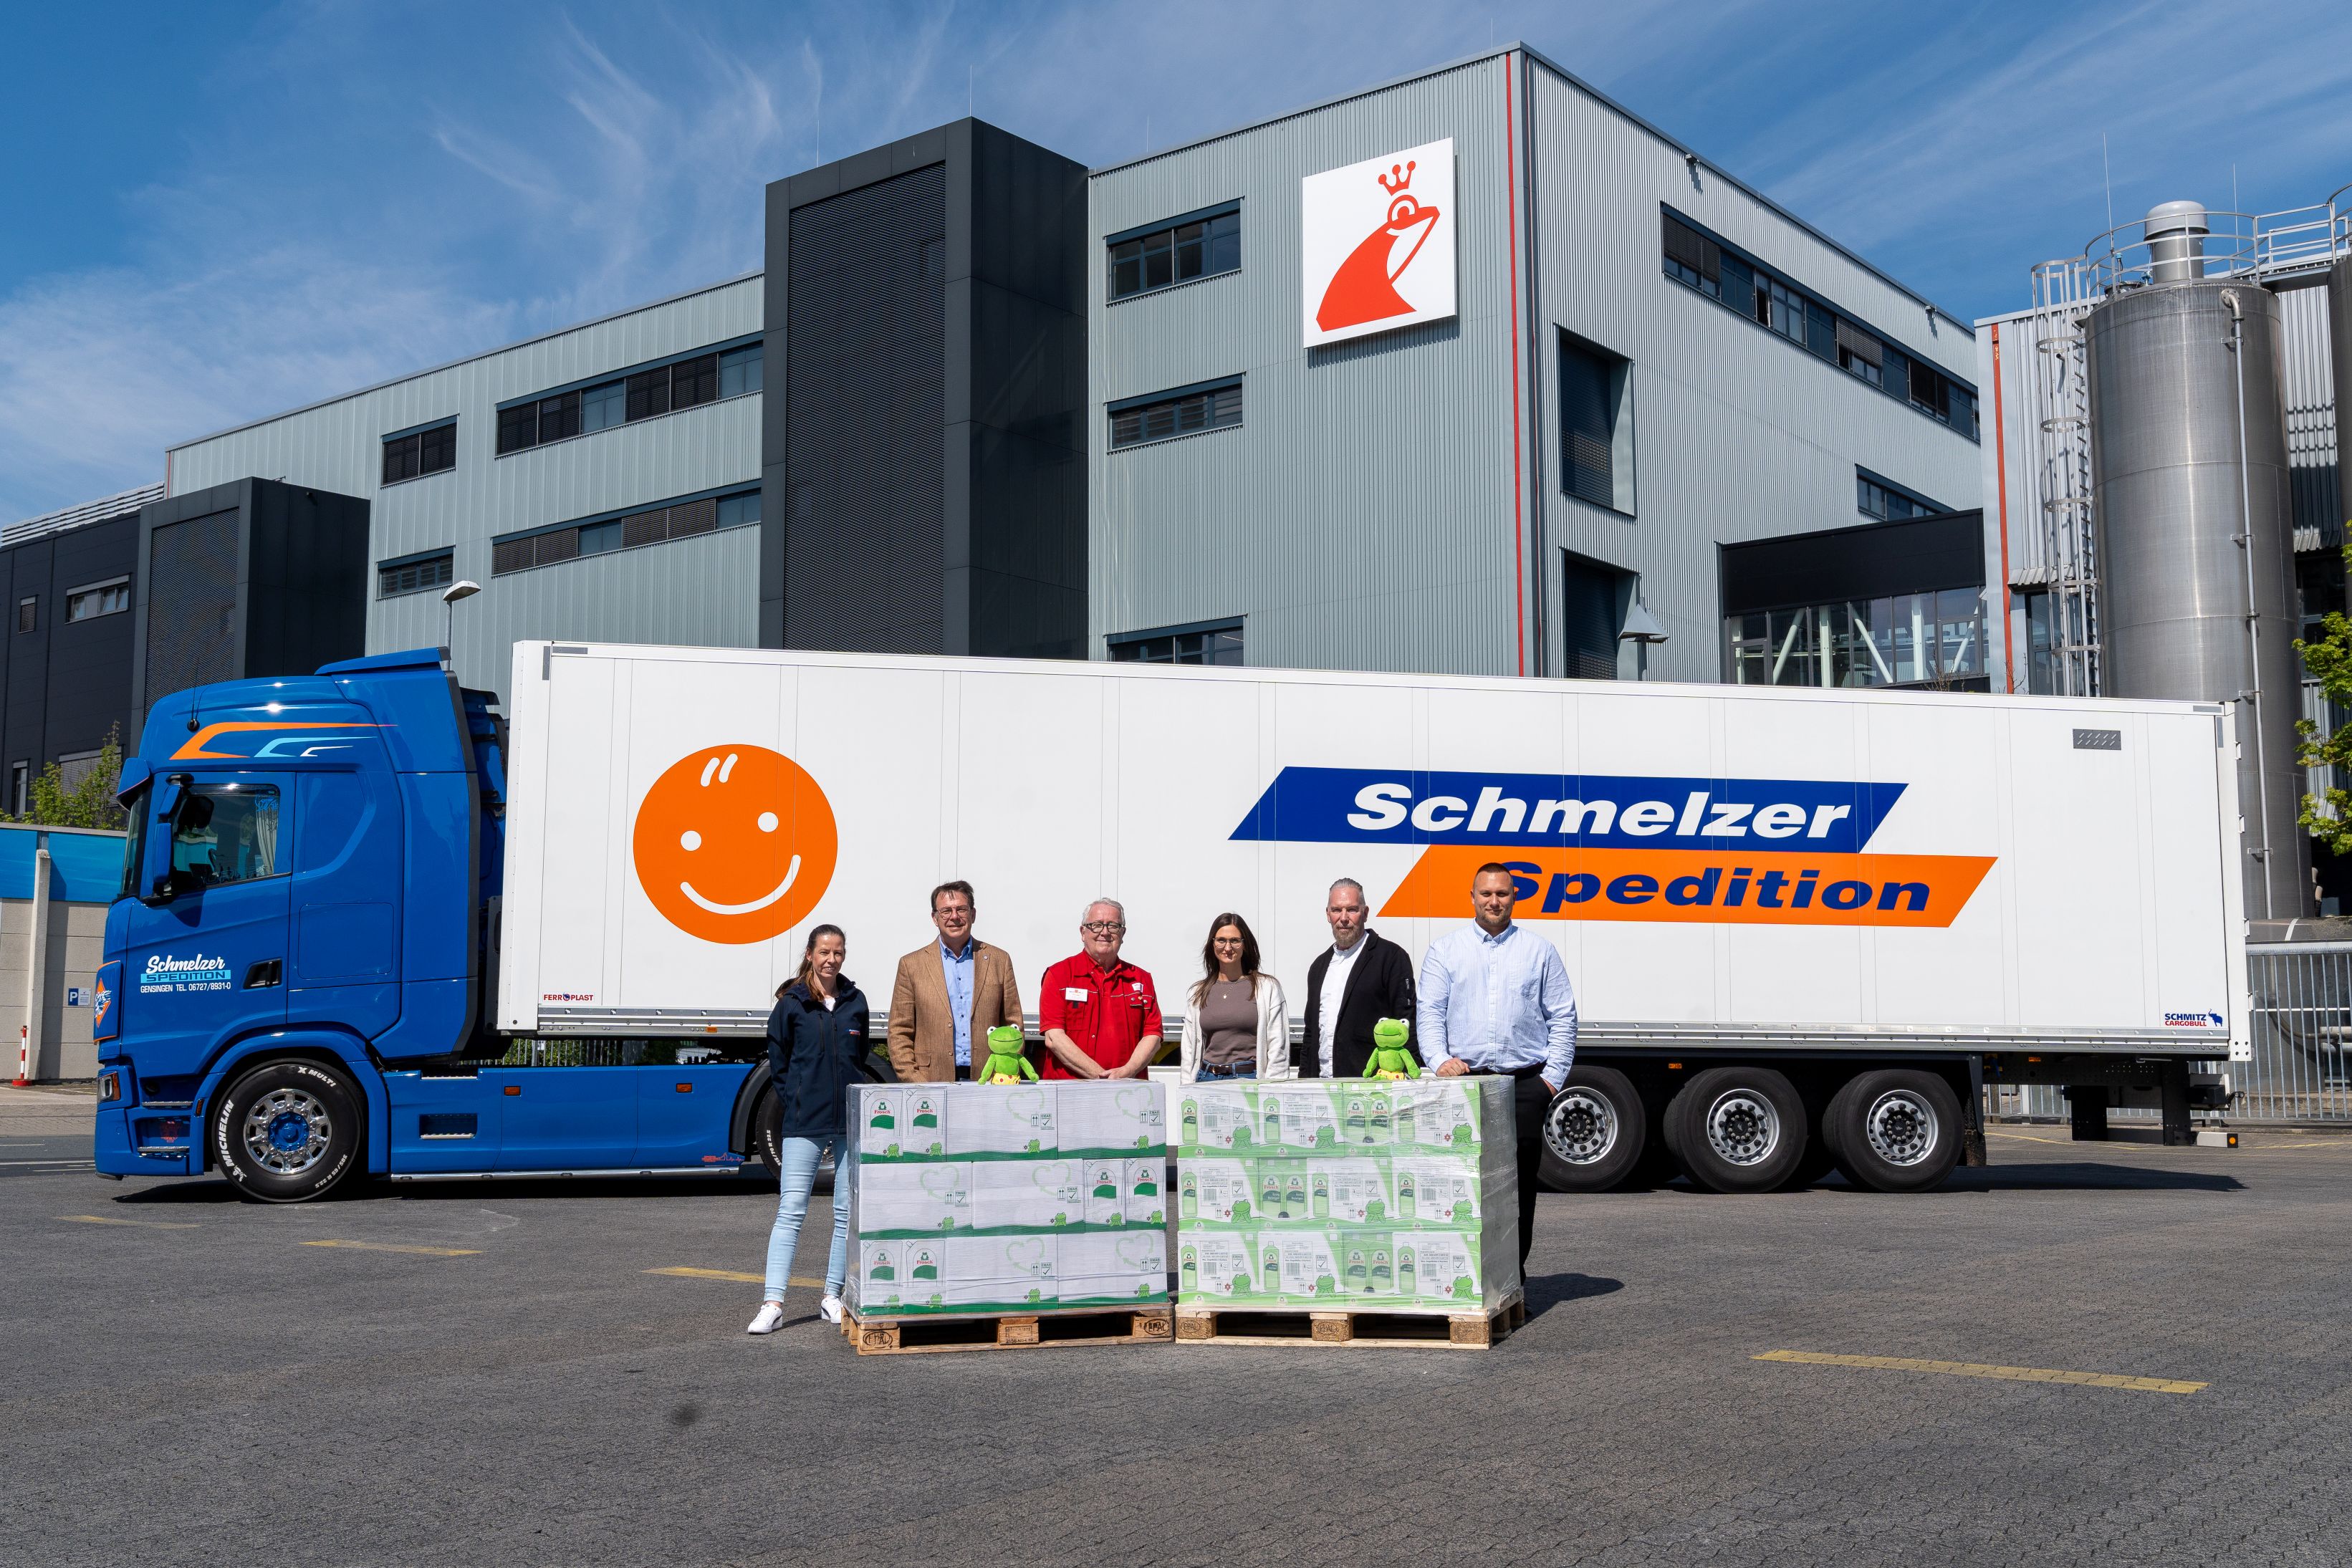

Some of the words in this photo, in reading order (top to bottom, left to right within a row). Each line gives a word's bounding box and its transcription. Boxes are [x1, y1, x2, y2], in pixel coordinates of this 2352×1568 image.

[1348, 784, 1851, 838] Schmelzer
[1499, 862, 1929, 913] Spedition
[145, 953, 226, 974] Schmelzer
[146, 971, 226, 982] SPEDITION
[140, 984, 173, 994] GENSINGEN
[188, 981, 231, 991] 06727/8931-0
[69, 991, 78, 1002] P
[543, 993, 594, 1001] FERROPLAST
[2164, 1013, 2207, 1021] SCHMITZ
[308, 1069, 337, 1087] MULTI
[219, 1099, 234, 1167] MICHELIN
